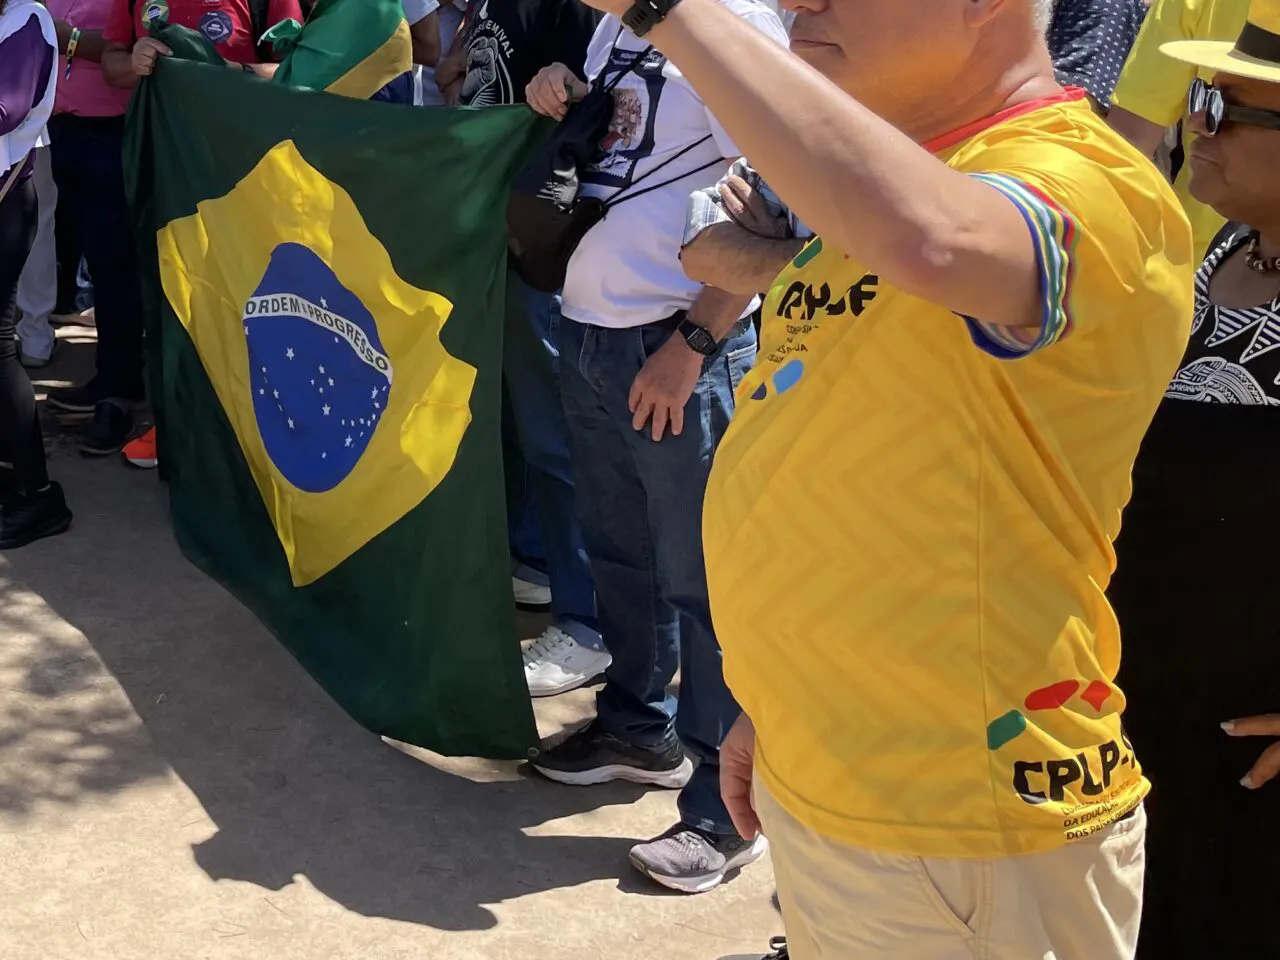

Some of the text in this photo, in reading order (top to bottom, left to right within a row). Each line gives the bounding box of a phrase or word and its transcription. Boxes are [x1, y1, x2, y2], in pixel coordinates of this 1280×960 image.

[245, 297, 301, 315] ORDEM
[309, 307, 389, 372] PROGRESSO
[1013, 740, 1136, 804] CPLP-
[1063, 818, 1079, 828] DA
[1066, 829, 1089, 841] DOS
